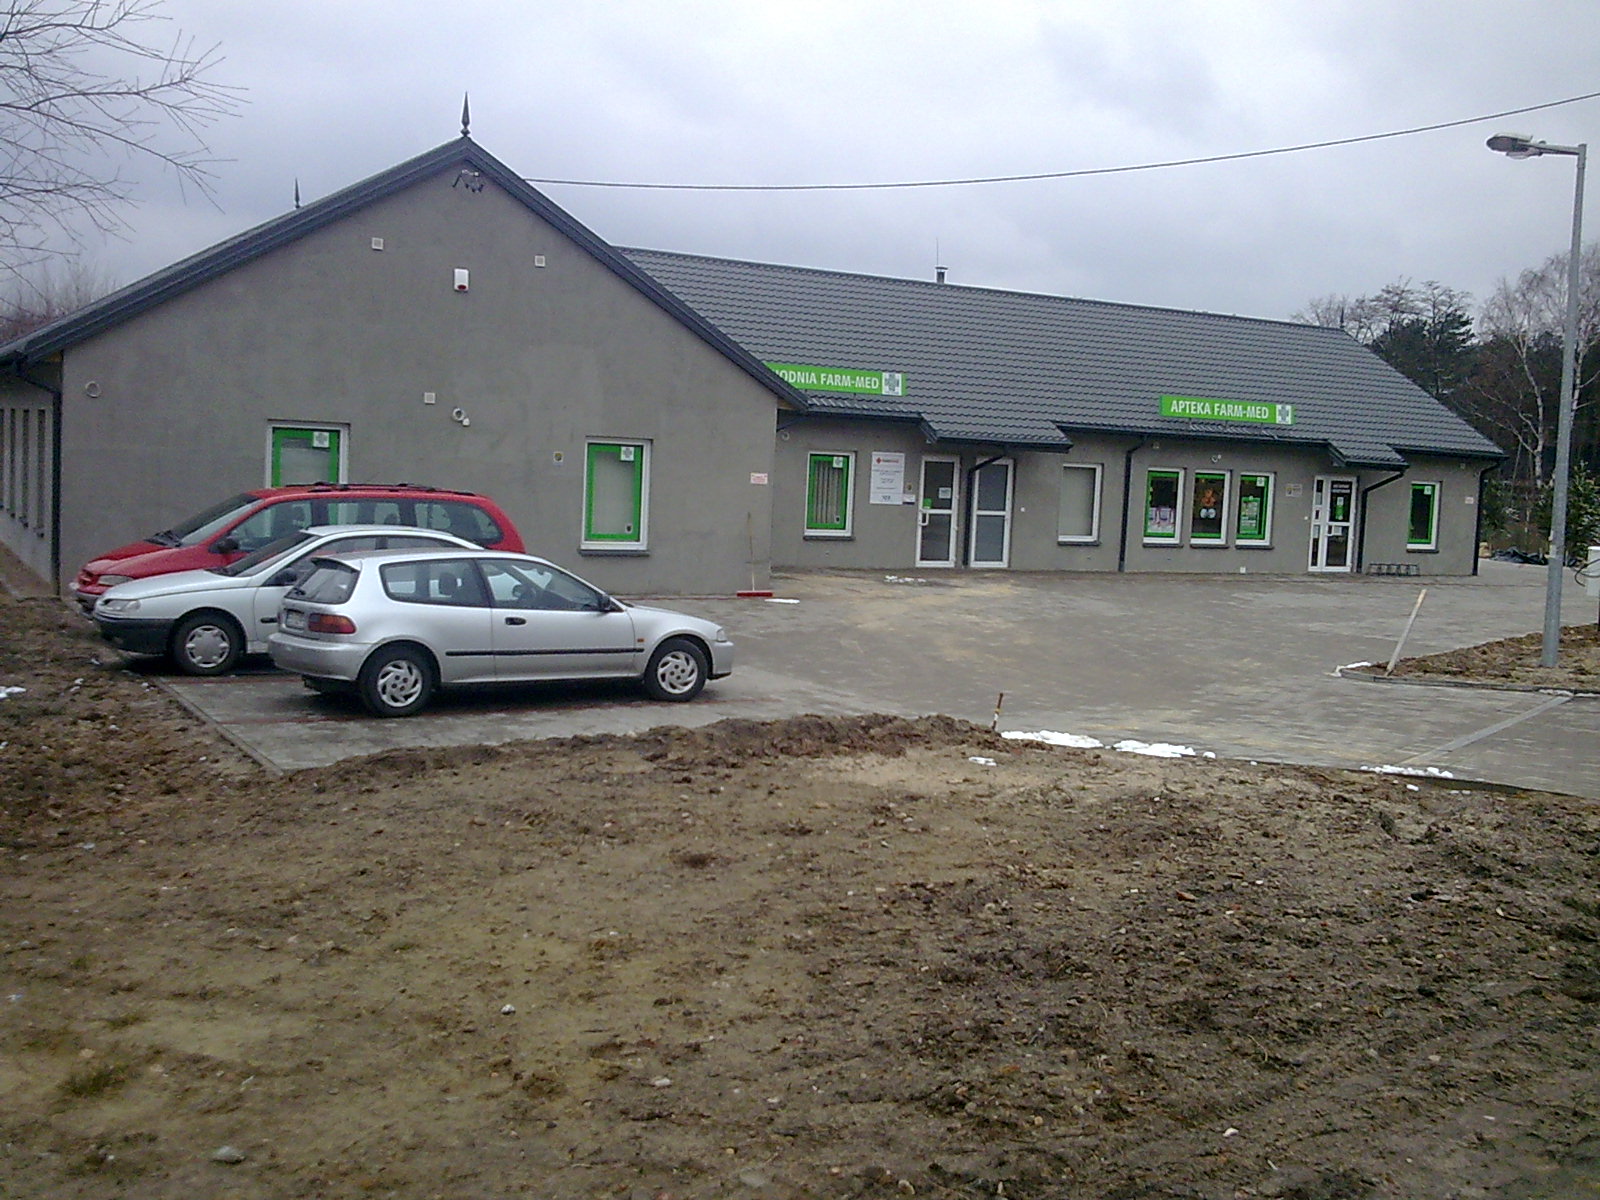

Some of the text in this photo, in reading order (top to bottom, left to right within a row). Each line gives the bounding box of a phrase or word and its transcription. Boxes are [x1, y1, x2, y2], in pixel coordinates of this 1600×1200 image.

[775, 369, 879, 389] ODNIA FARM-MED
[1170, 400, 1269, 419] APTEKA FARM-MED
